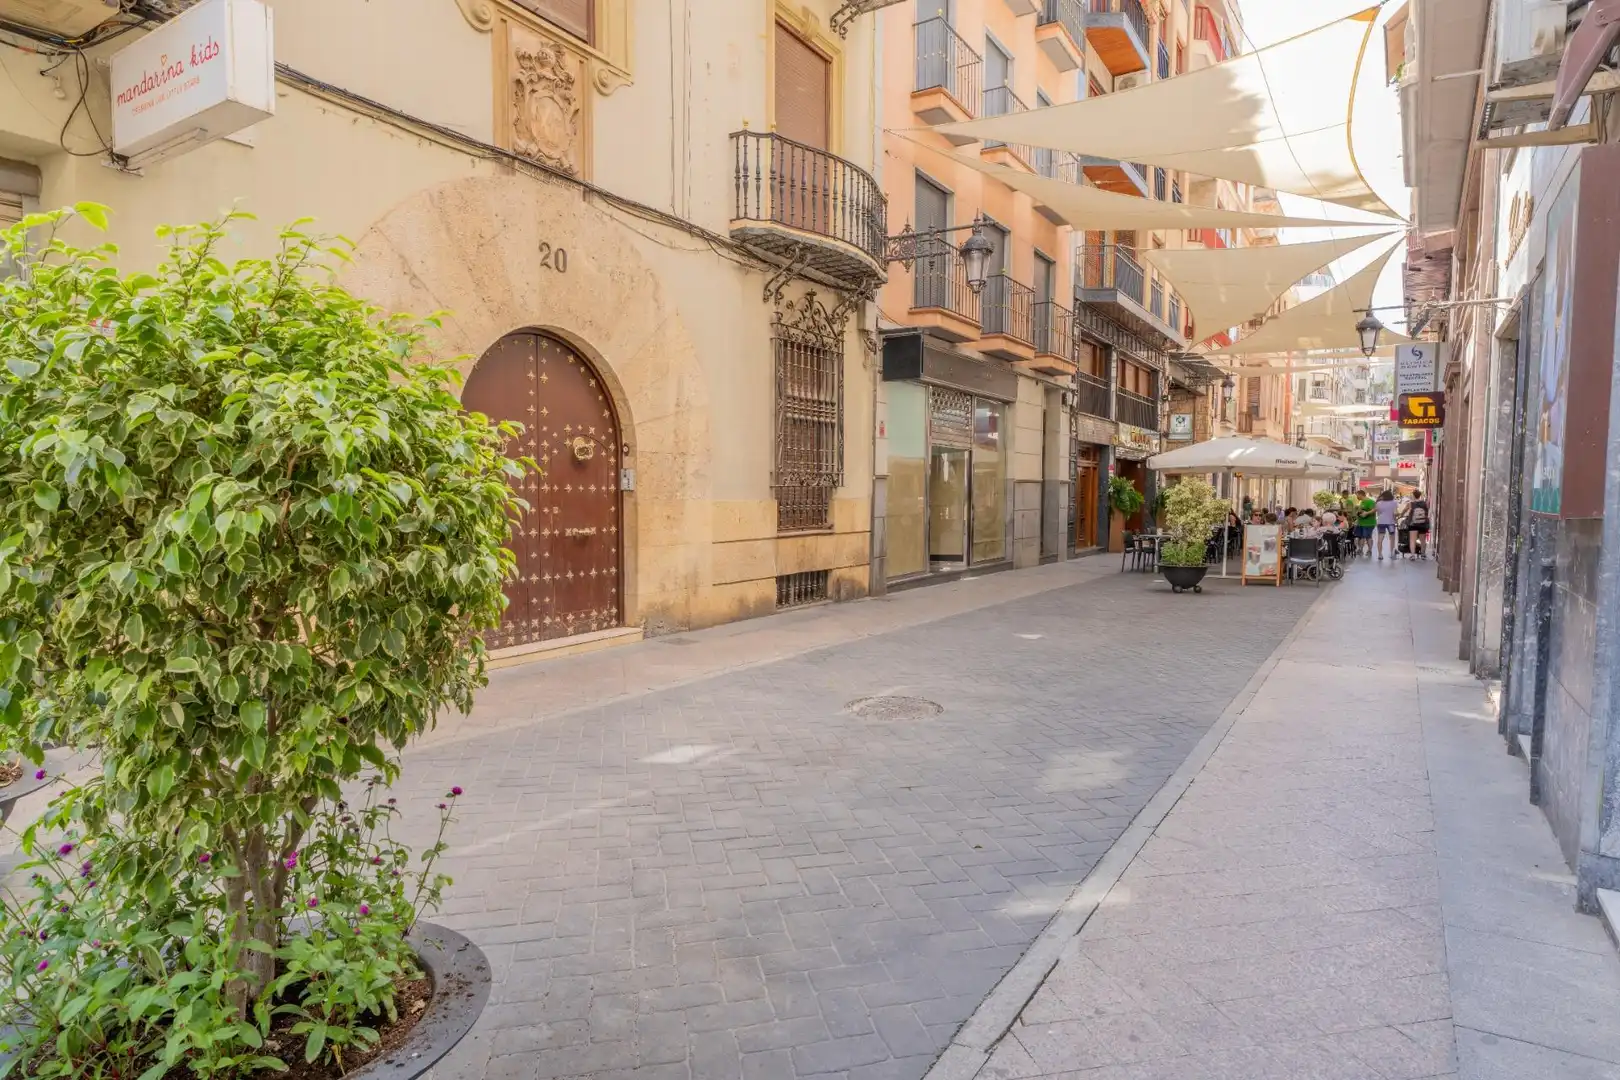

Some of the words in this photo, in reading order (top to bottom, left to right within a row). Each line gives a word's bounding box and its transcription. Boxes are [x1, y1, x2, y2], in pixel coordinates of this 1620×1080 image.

[116, 60, 184, 107] mandarina
[189, 36, 220, 69] kids
[538, 240, 568, 274] 20
